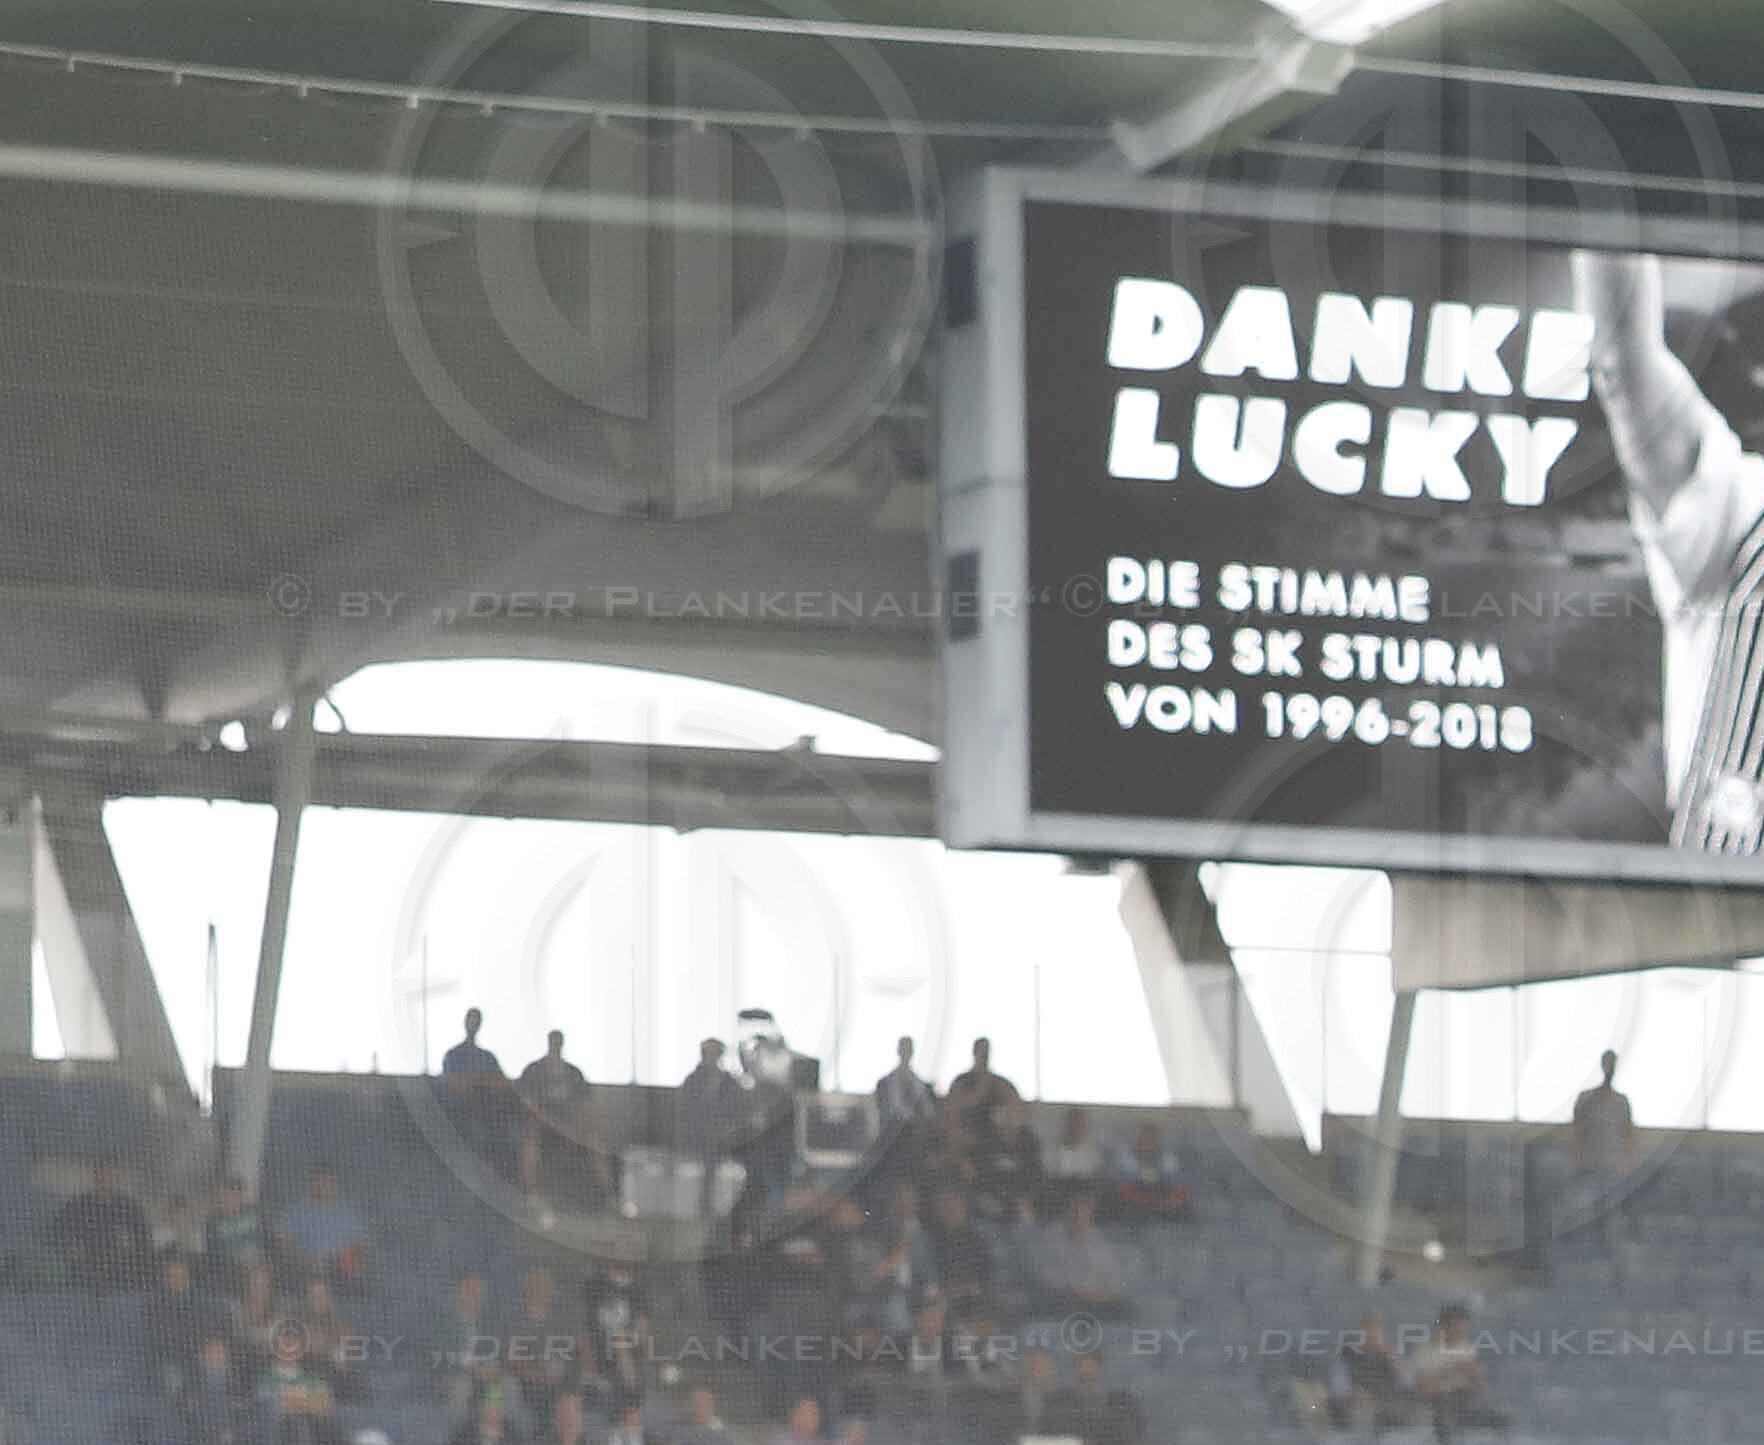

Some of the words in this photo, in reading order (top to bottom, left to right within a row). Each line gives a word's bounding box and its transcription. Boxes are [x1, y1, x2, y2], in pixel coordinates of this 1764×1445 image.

[1107, 277, 1596, 400] DANKE
[1107, 388, 1578, 506] LUCKY
[1106, 556, 1200, 609] DIE
[1218, 562, 1430, 623] STIMME
[1106, 619, 1213, 671] DES
[1231, 627, 1303, 678] SK
[1320, 632, 1505, 688] STURM
[1105, 681, 1238, 735] VON
[1262, 690, 1533, 753] 1996-2018
